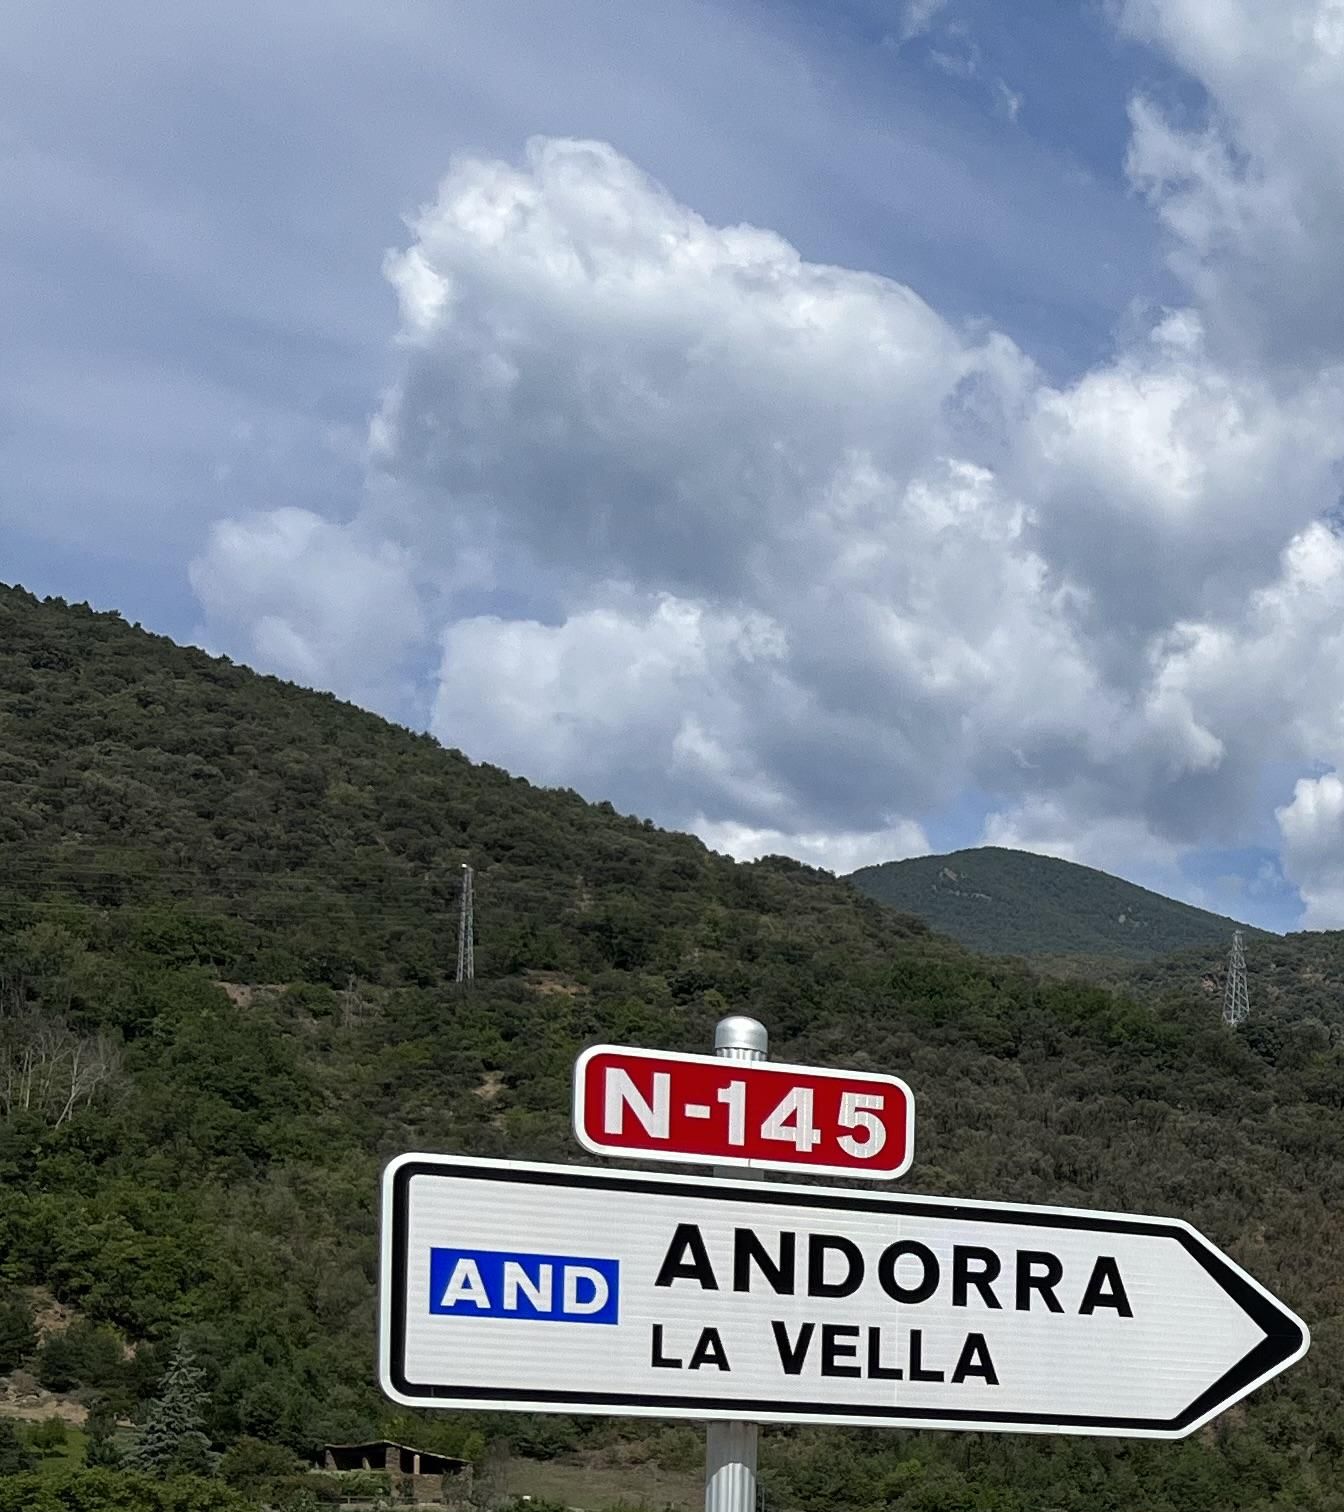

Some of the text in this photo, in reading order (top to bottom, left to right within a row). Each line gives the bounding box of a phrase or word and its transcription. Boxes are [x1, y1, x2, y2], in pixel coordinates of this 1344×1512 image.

[604, 1067, 887, 1159] N-145
[440, 1258, 609, 1315] AND
[654, 1223, 1134, 1318] ANDORRA
[651, 1320, 1000, 1386] LA VELLA
